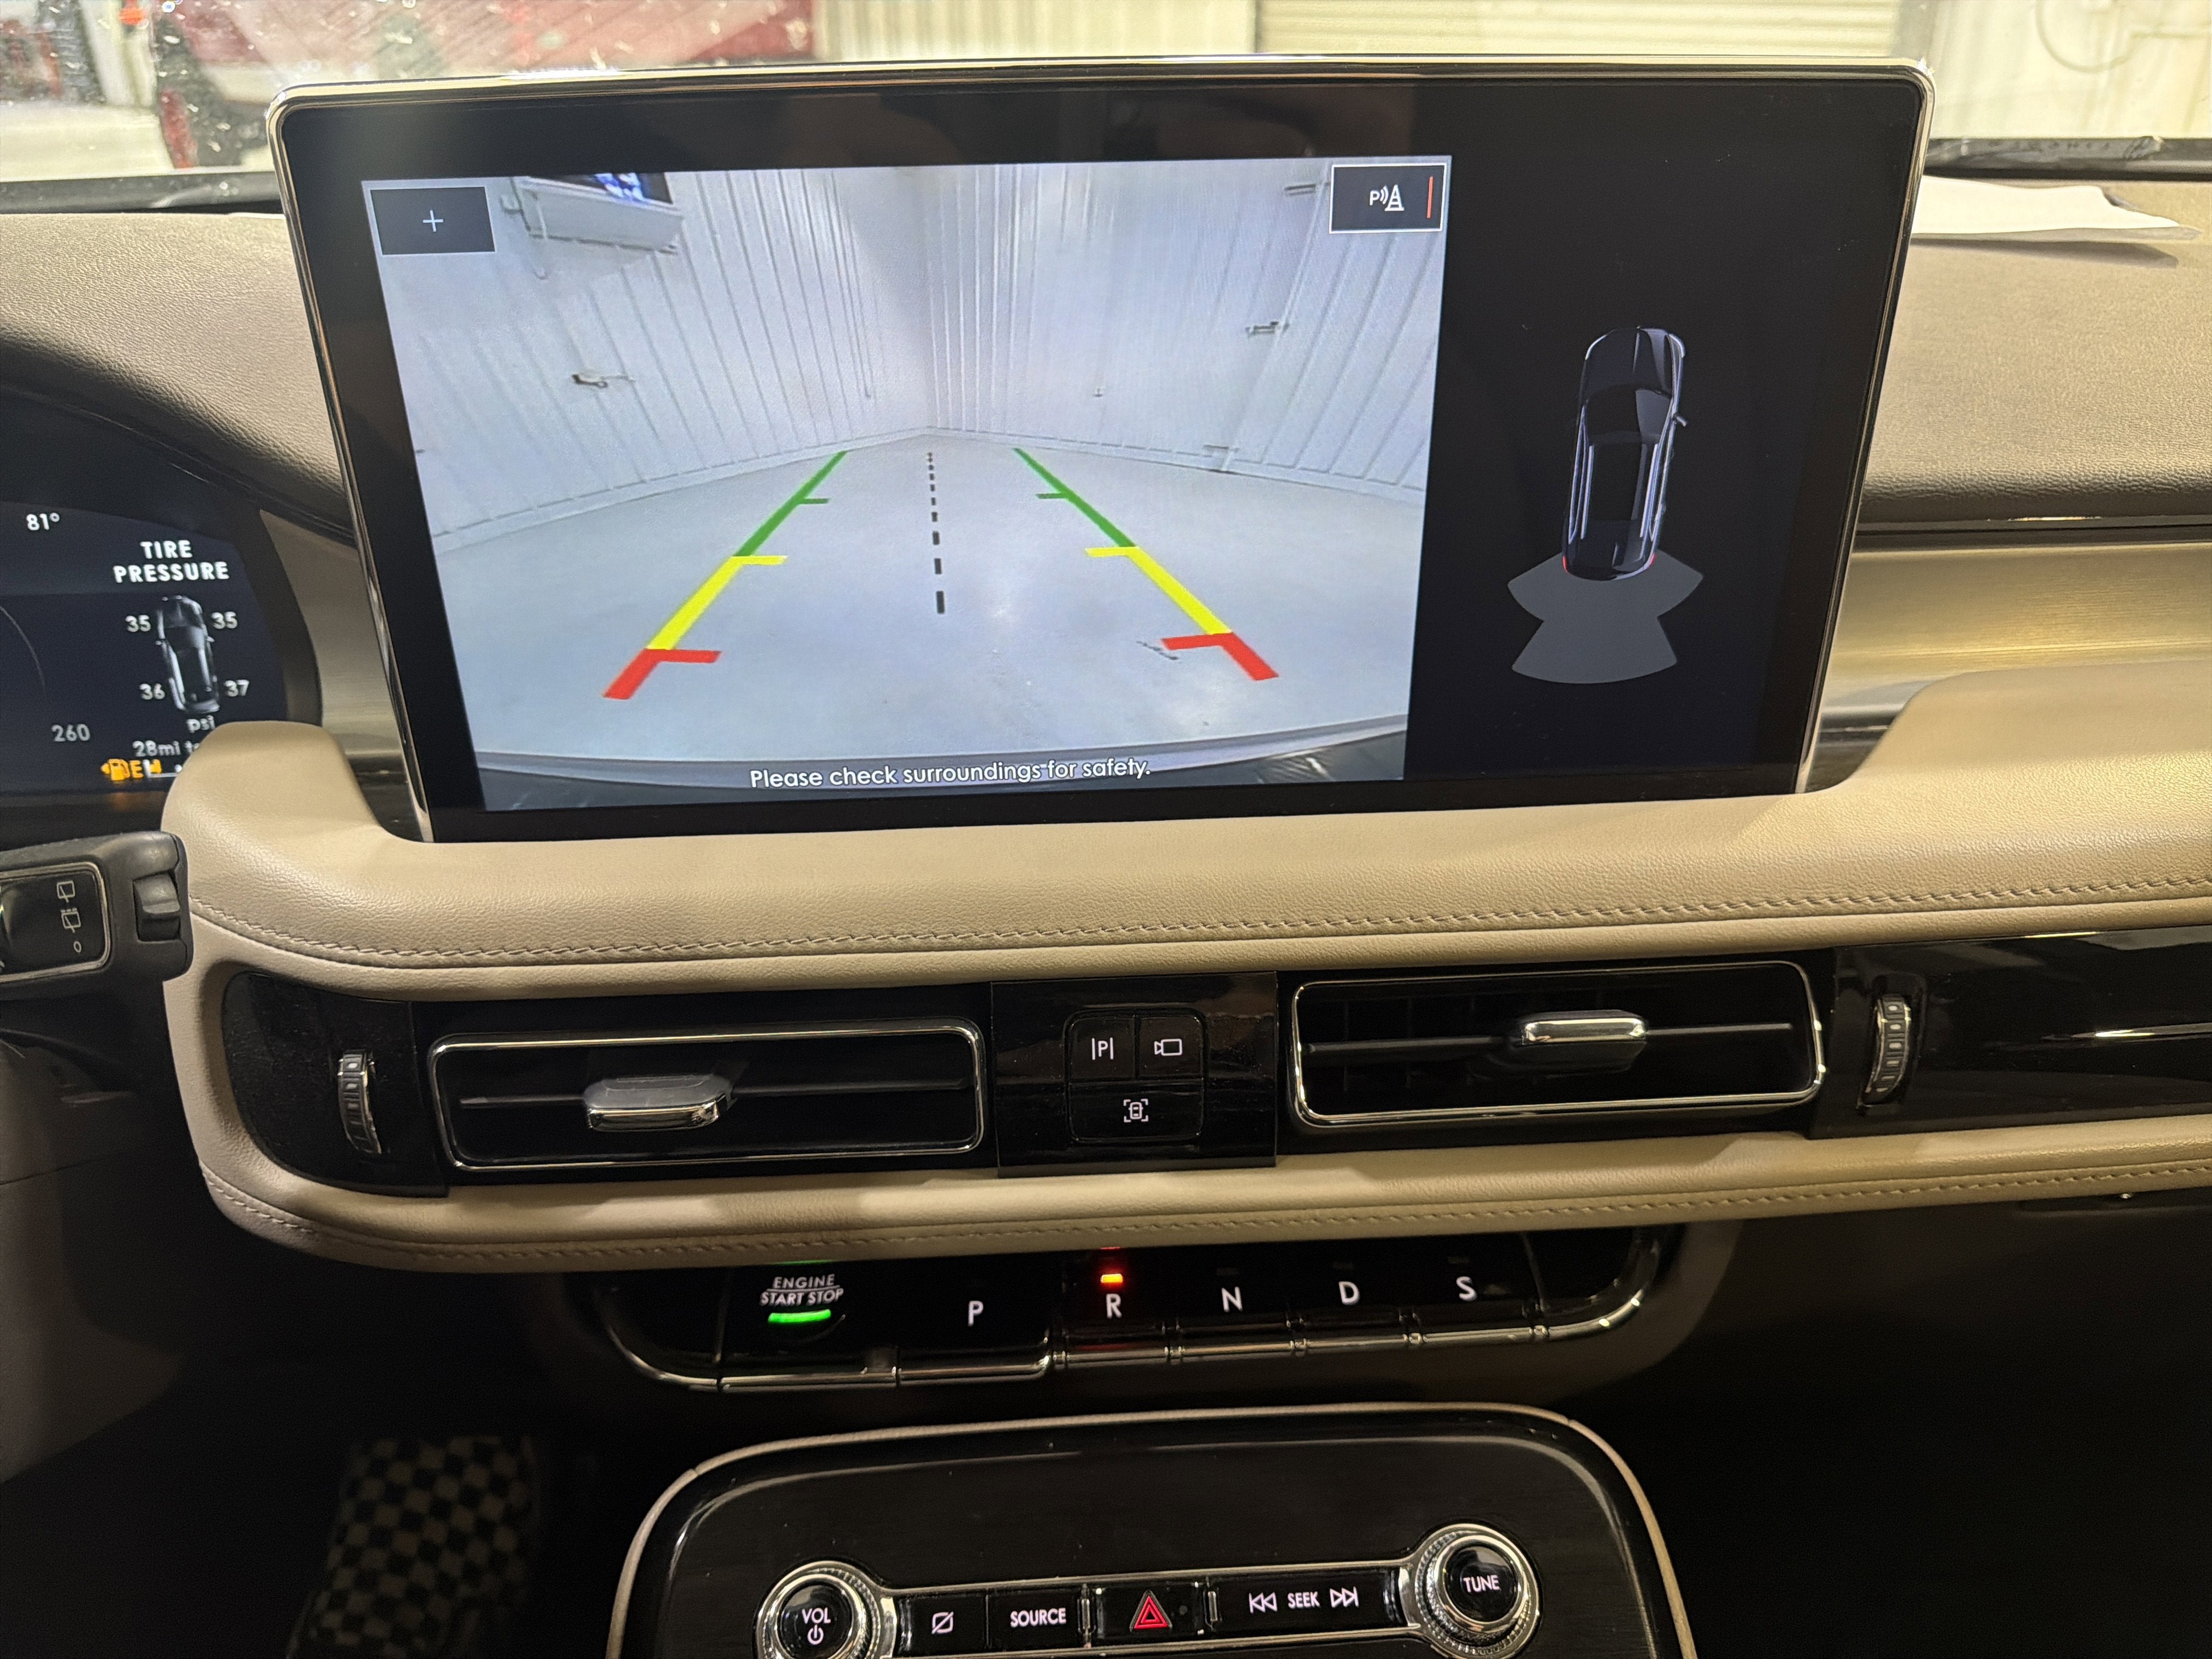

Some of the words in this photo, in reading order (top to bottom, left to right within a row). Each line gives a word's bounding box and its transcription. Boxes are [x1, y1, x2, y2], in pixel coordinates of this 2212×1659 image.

[141, 540, 192, 559] TIRE
[114, 561, 229, 583] PRESSURE
[126, 615, 150, 633] 35
[211, 612, 237, 630] 35
[140, 683, 165, 701] 36
[224, 680, 249, 697] 37
[52, 724, 91, 742] 260
[186, 715, 215, 733] psi
[133, 741, 181, 757] 28mi
[750, 770, 822, 787] Please
[830, 765, 897, 785] check
[903, 761, 1041, 783] surroundings
[1047, 760, 1077, 778] for
[1082, 758, 1151, 779] safety.
[772, 1274, 835, 1289] ENGINE
[1456, 1276, 1477, 1301] S
[760, 1291, 804, 1306] START
[806, 1288, 844, 1306] STOP
[1221, 1286, 1243, 1312] N
[1338, 1281, 1360, 1306] D
[968, 1300, 984, 1327] P
[1105, 1293, 1122, 1318] R
[1463, 1574, 1501, 1593] TUNE
[1287, 1592, 1321, 1609] SEEK
[802, 1607, 831, 1624] VOL
[1010, 1607, 1066, 1628] SOURCE
